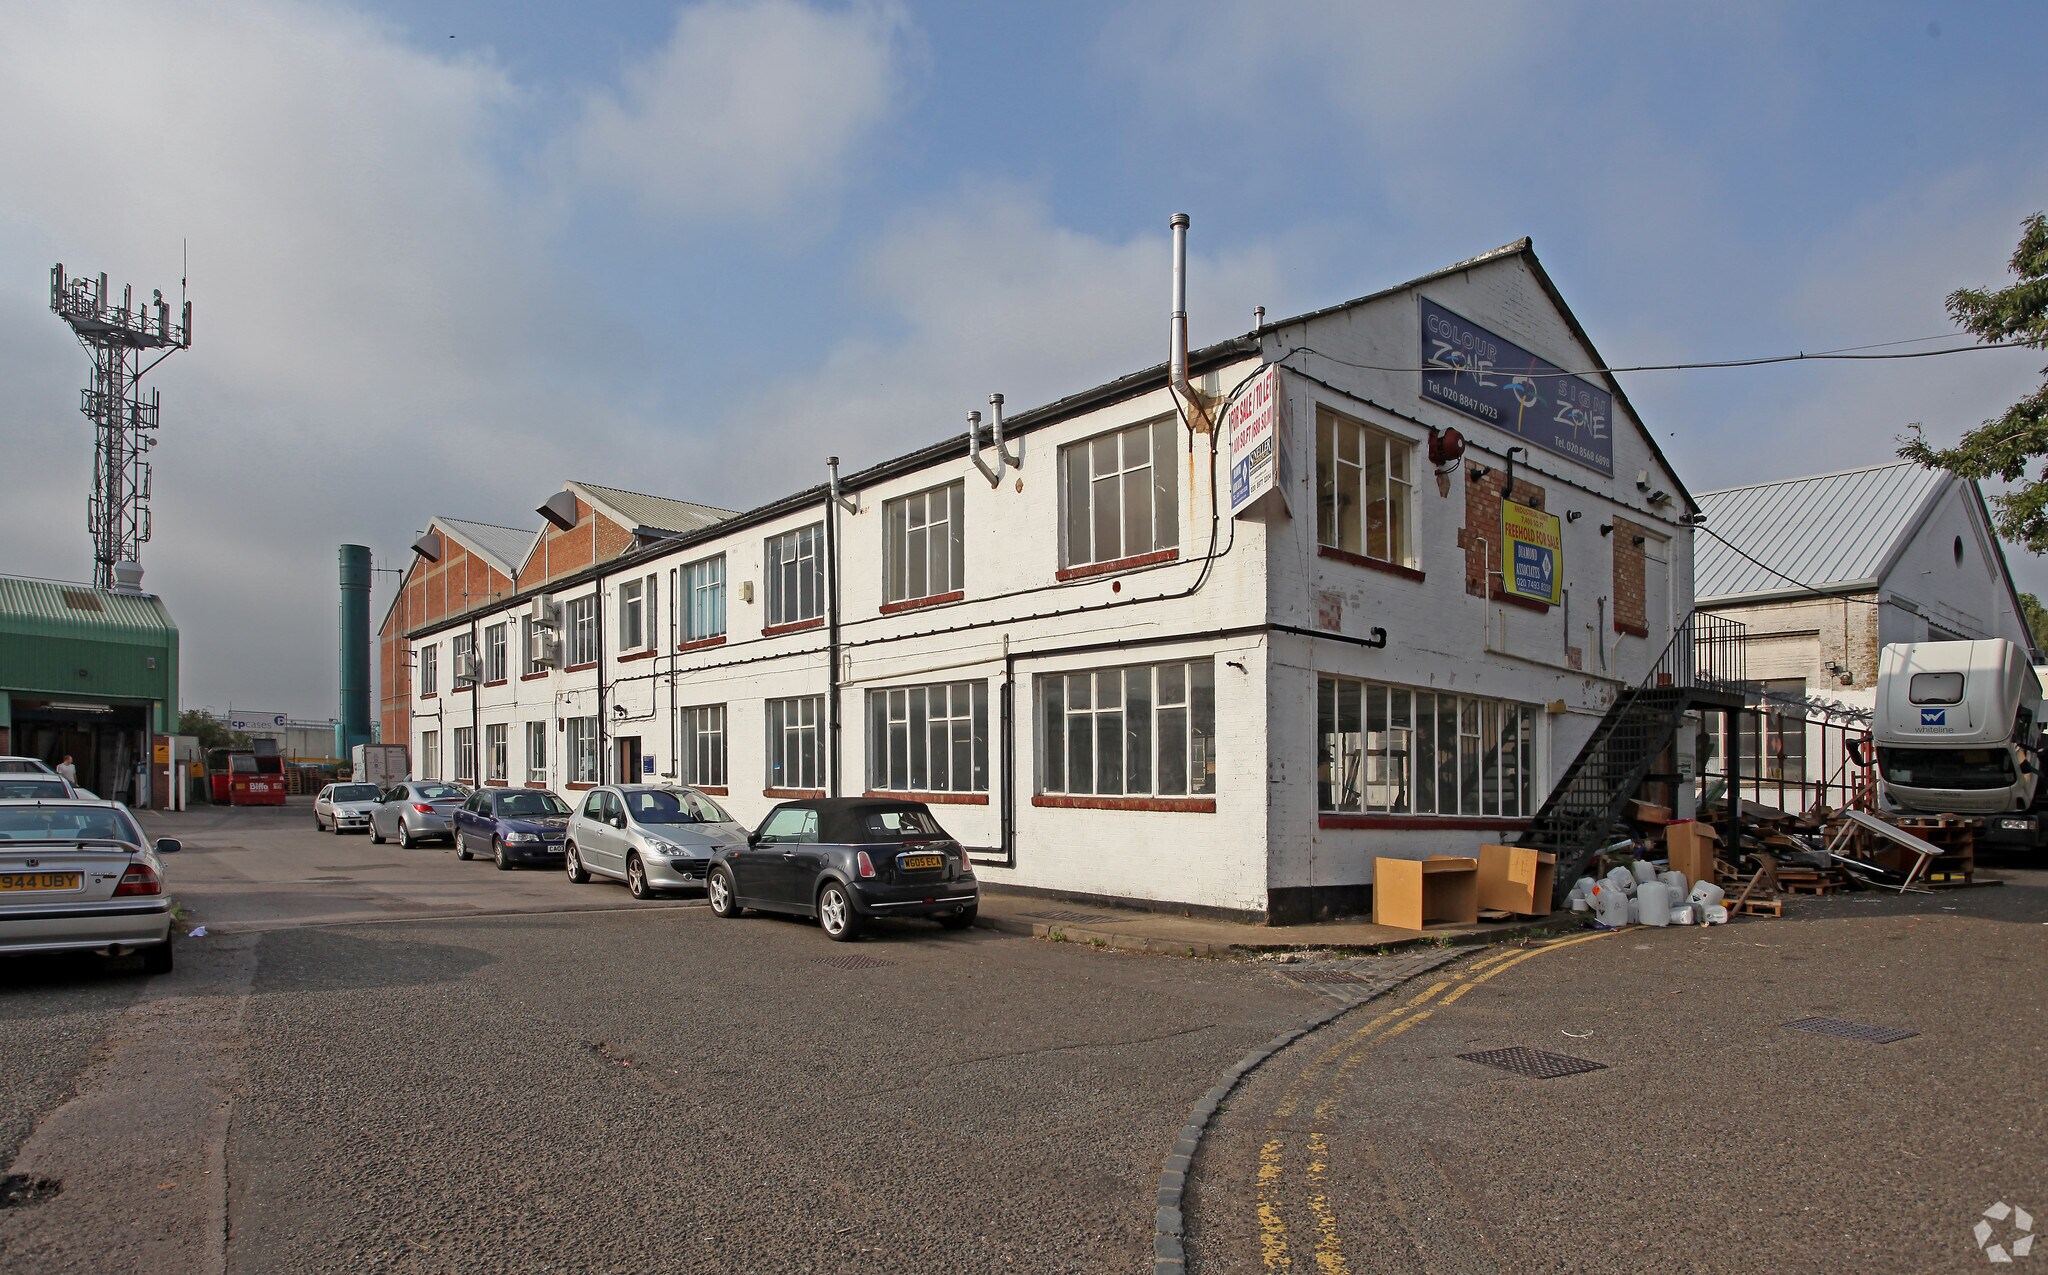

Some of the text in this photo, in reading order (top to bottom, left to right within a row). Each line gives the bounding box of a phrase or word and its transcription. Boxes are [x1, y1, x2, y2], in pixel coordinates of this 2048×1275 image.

[1427, 314, 1497, 363] COLOUR
[1427, 338, 1498, 387] ZONE
[1231, 406, 1240, 432] FOR
[1239, 392, 1253, 425] SALE
[1256, 382, 1263, 410] TO
[1263, 371, 1273, 403] LET
[1428, 380, 1498, 419] Tel. 020 8847 0923
[1558, 379, 1606, 416] SIGN
[1553, 399, 1609, 440] ZONE
[1554, 435, 1566, 449] Tel.
[1566, 441, 1579, 454] 020
[1579, 446, 1595, 462] 8568
[1505, 522, 1560, 550] FREEHOLD FOR SALE
[1518, 545, 1538, 561] DIAMOND
[1516, 562, 1541, 579] ASSOCIATES
[1516, 578, 1526, 587] 020
[1527, 580, 1540, 590] 7493
[1914, 726, 1954, 734] whiteline
[249, 782, 269, 790] Biffa
[905, 858, 926, 868] WG05
[926, 856, 941, 866] ECA
[42, 874, 75, 887] UBY
